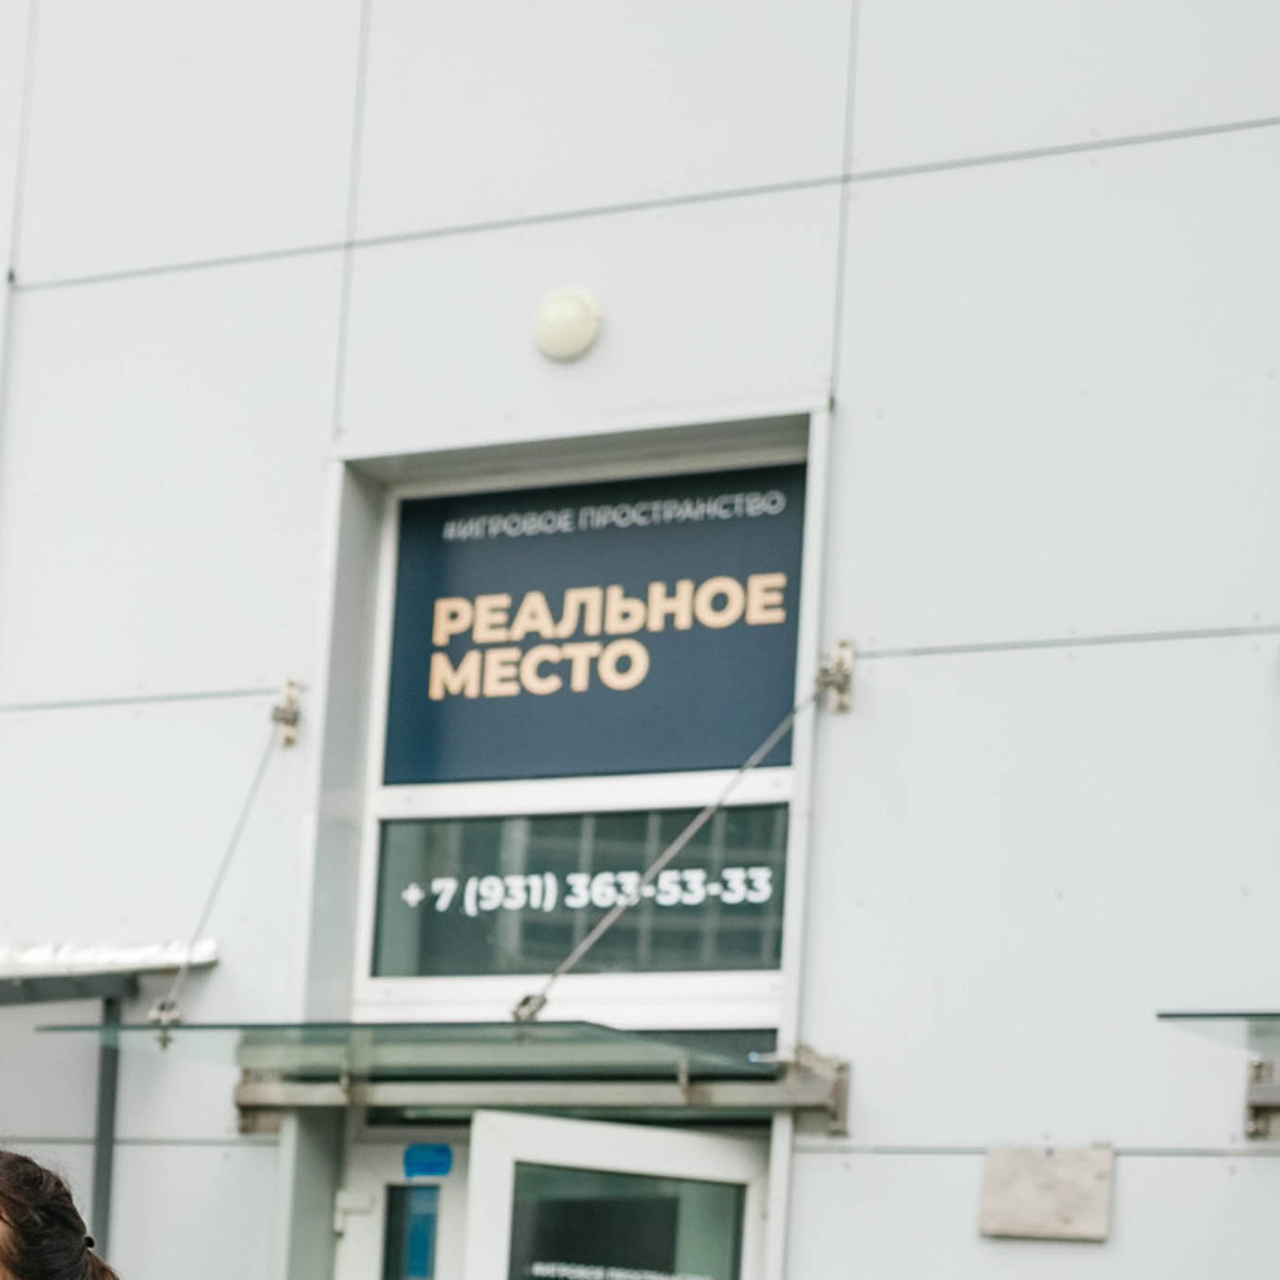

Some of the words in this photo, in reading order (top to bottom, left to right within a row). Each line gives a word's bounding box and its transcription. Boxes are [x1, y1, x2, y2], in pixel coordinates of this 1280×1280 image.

[443, 507, 575, 541] #ИГРОВОЕ
[578, 490, 787, 530] ПРОСТРАНСТВО
[432, 572, 787, 647] РЕАЛЬНОЕ
[429, 638, 650, 700] МЕСТО
[464, 872, 558, 917] (931)
[564, 866, 772, 908] 363-53-33
